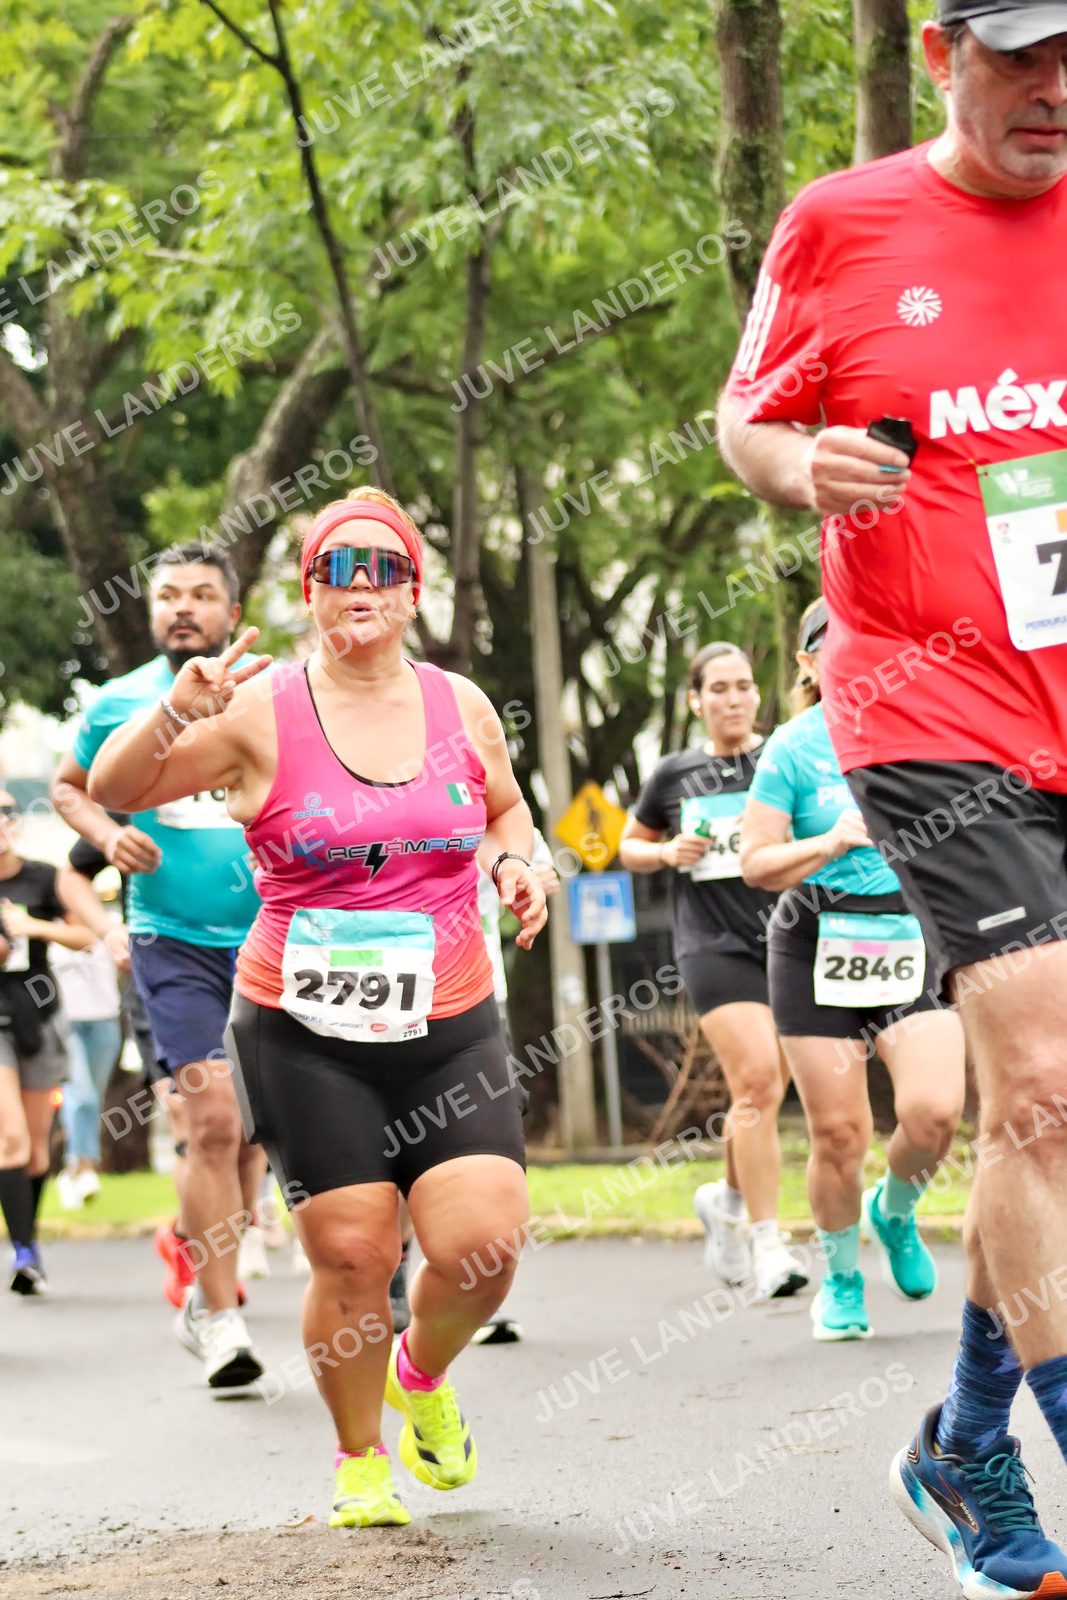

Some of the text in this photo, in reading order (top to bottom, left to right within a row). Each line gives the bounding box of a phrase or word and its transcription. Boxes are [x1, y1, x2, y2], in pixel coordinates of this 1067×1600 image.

[824, 955, 914, 981] 2846
[294, 968, 417, 1012] 2791
[403, 1029, 422, 1038] 2791
